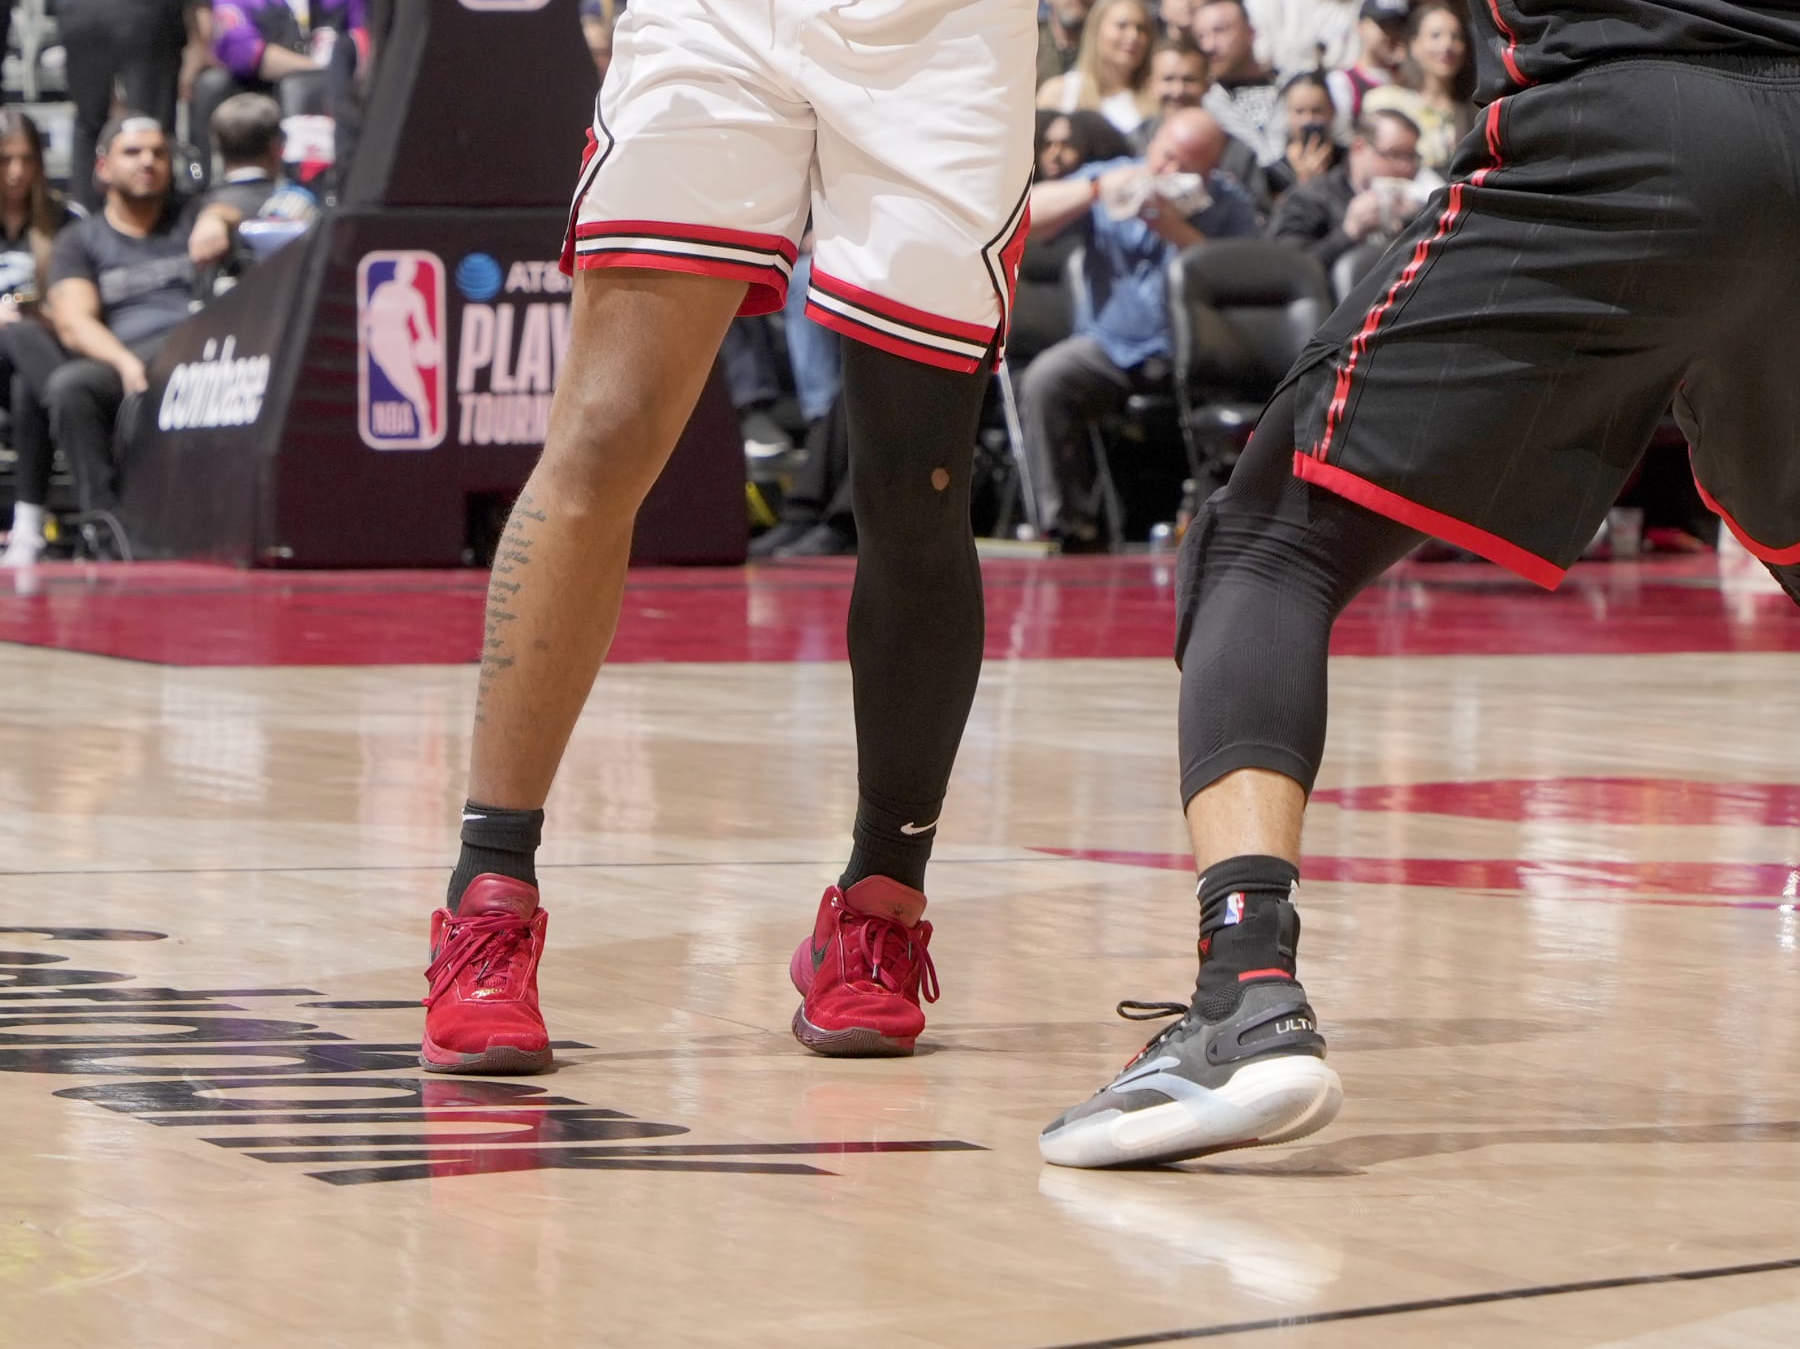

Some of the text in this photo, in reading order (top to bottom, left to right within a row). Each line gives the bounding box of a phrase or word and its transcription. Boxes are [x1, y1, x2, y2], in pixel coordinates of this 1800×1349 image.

[505, 261, 573, 293] AT&
[159, 334, 270, 432] coinbase
[372, 401, 415, 436] NBA
